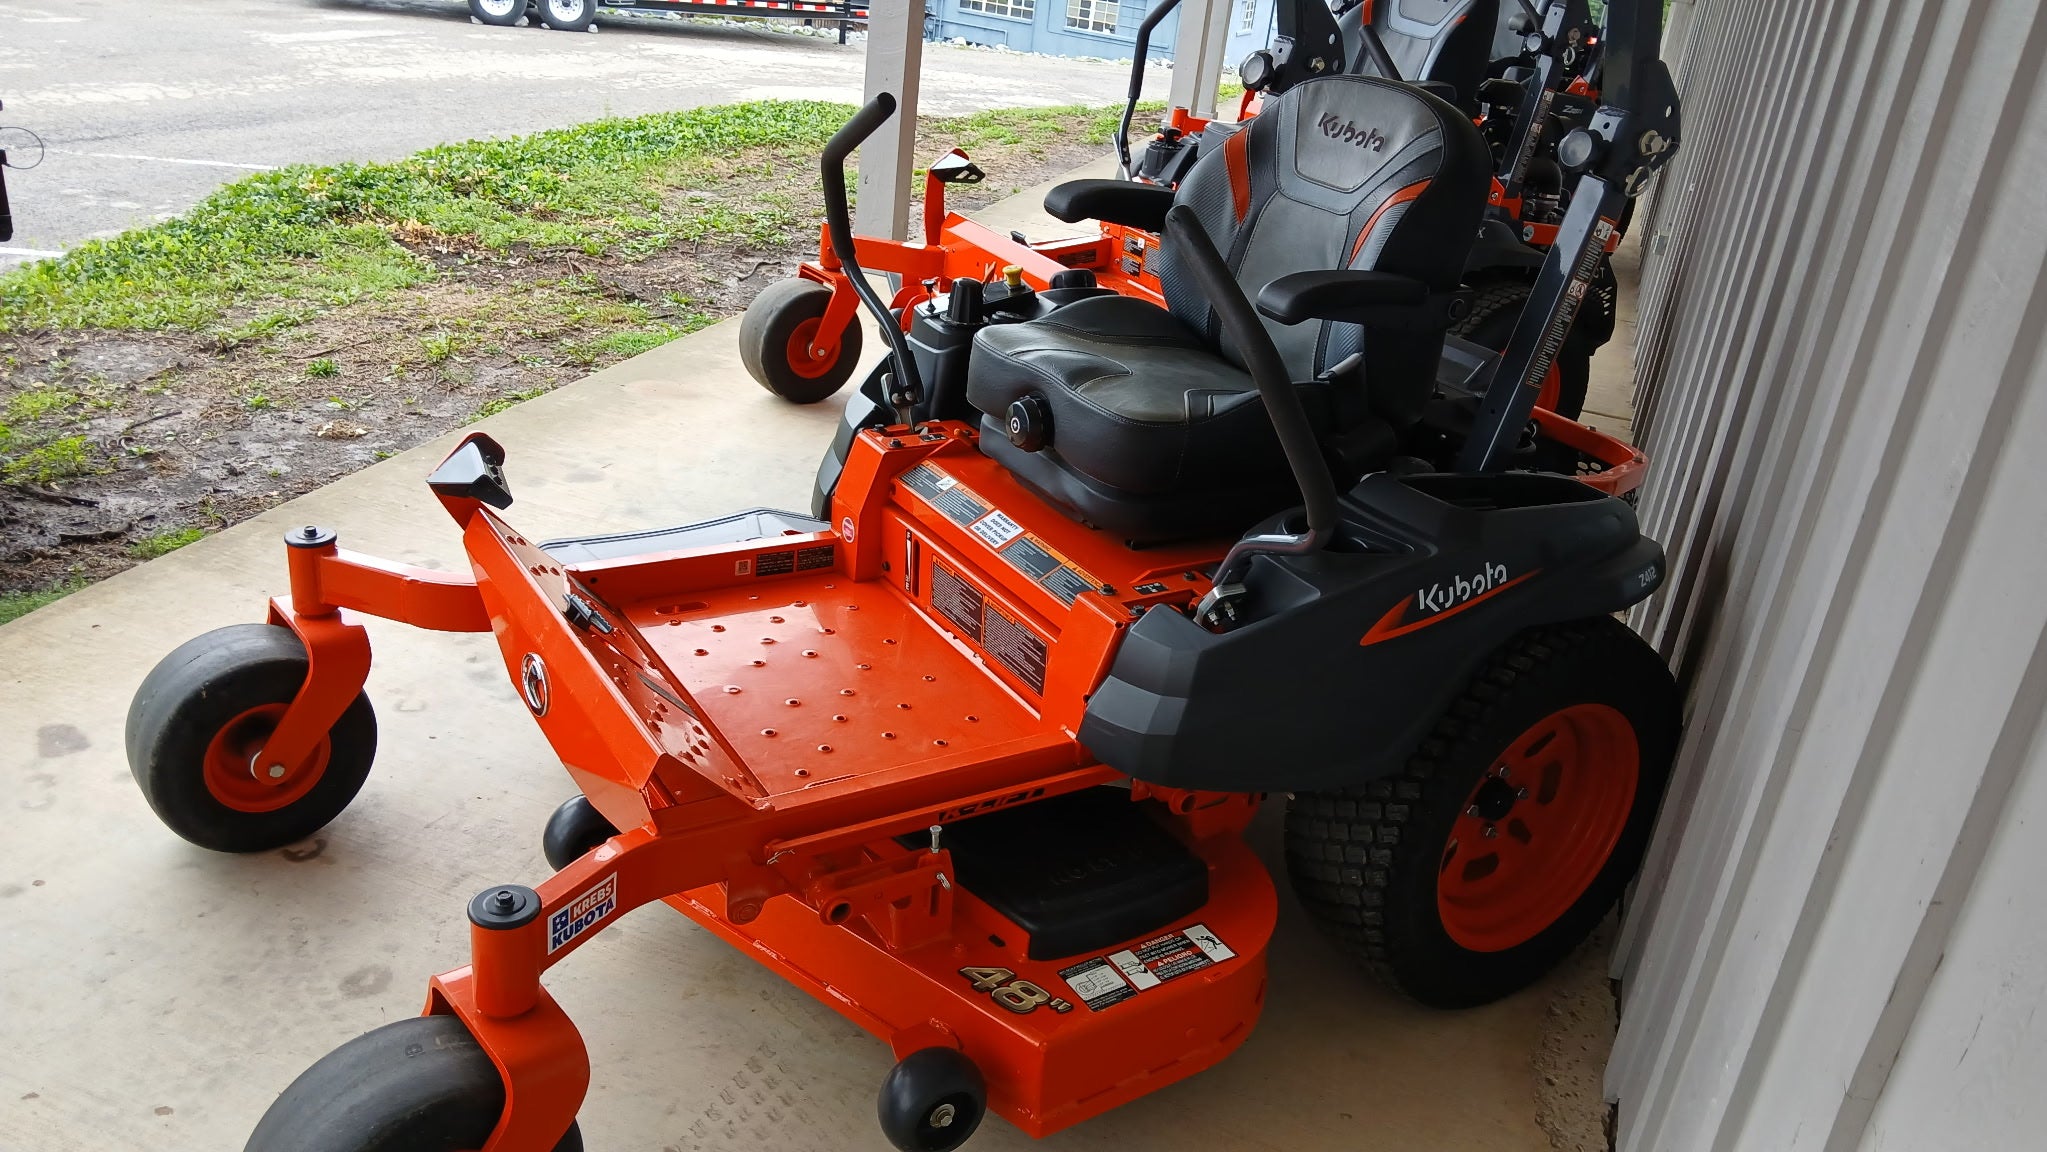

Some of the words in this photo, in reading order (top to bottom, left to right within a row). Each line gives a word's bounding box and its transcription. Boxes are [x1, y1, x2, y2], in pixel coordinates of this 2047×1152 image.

[1317, 112, 1385, 152] Kubota
[979, 519, 994, 531] COVER
[991, 529, 1008, 541] PICKUP
[990, 518, 1002, 528] DOES
[1000, 526, 1011, 534] NOT
[996, 513, 1019, 530] WARRANTY
[979, 529, 999, 545] DELIVERY
[1418, 562, 1507, 612] Kubota
[573, 882, 612, 918] KREBS
[552, 897, 614, 950] KUBOTA
[1145, 933, 1174, 946] DANGER
[1163, 950, 1193, 964] PELIGRO
